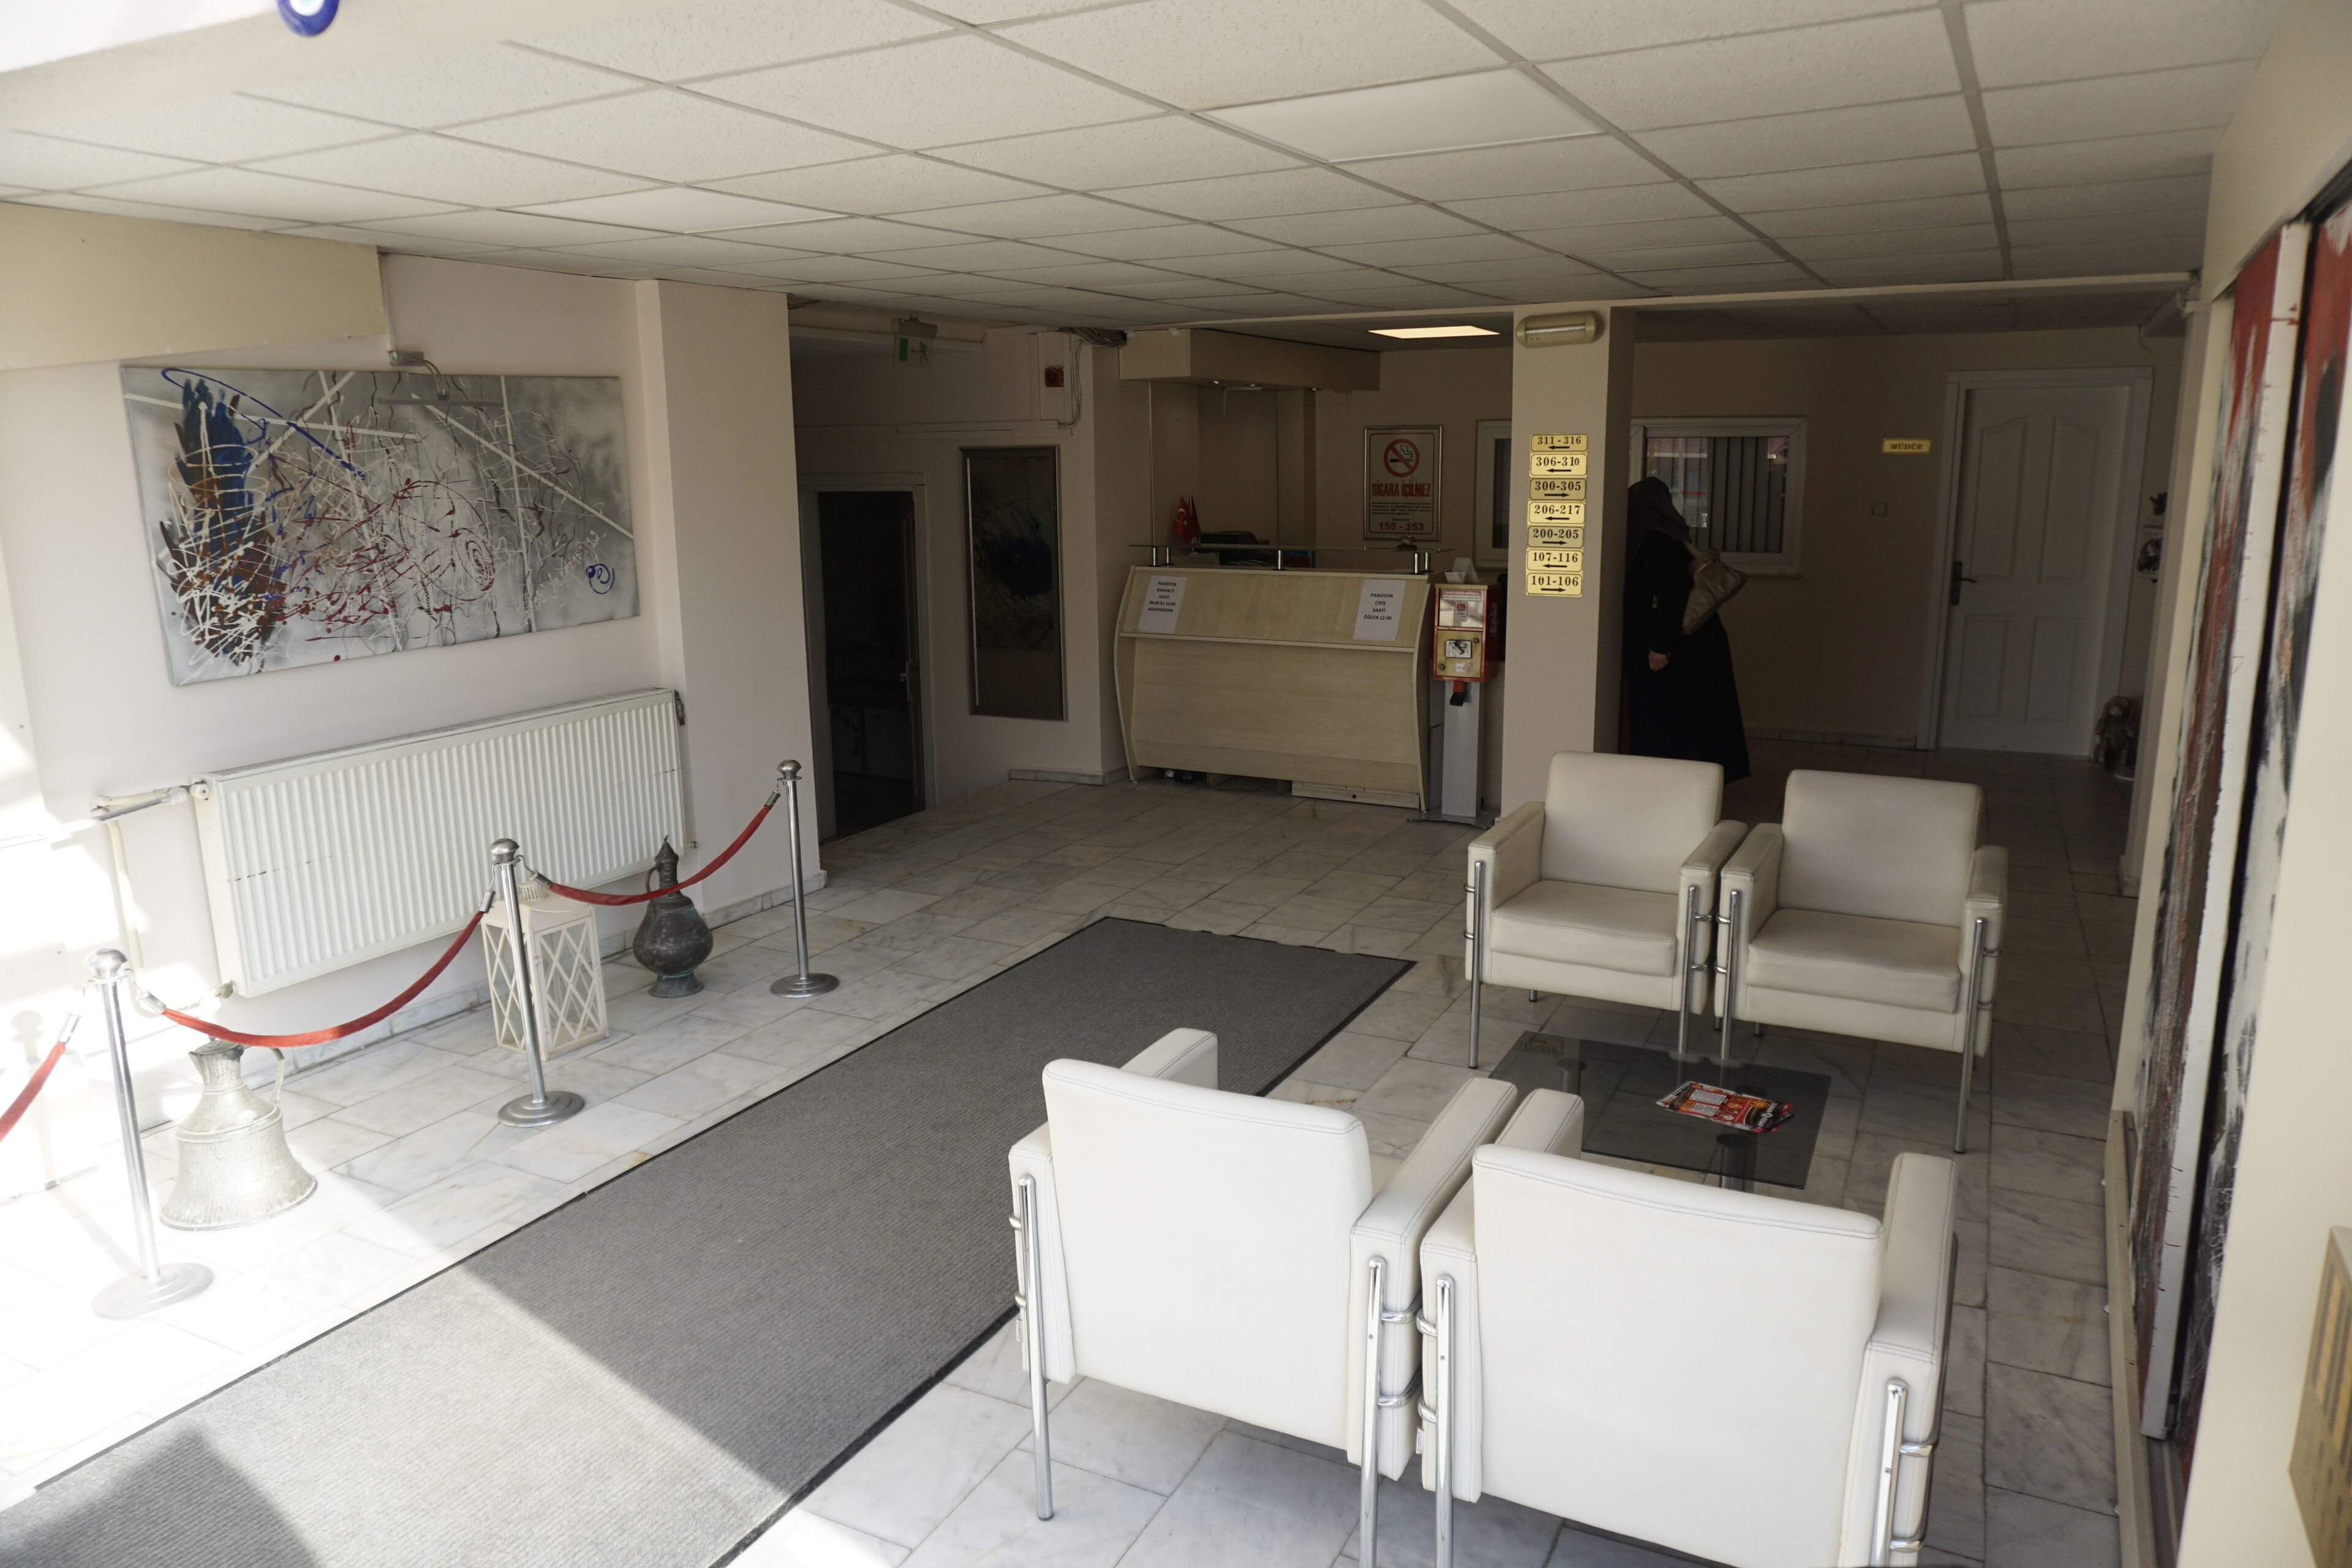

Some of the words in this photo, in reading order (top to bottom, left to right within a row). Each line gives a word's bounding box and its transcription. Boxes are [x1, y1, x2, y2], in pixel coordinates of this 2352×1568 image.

[1536, 456, 1580, 467] 306-310
[1371, 480, 1400, 497] SİGARA
[1401, 480, 1431, 499] İÇİLMEZ
[1534, 481, 1581, 491] 300-305
[1534, 505, 1580, 514] 206-217
[1532, 529, 1579, 539] 200-205
[1532, 552, 1578, 562] 107-116
[1531, 576, 1578, 586] 101-106
